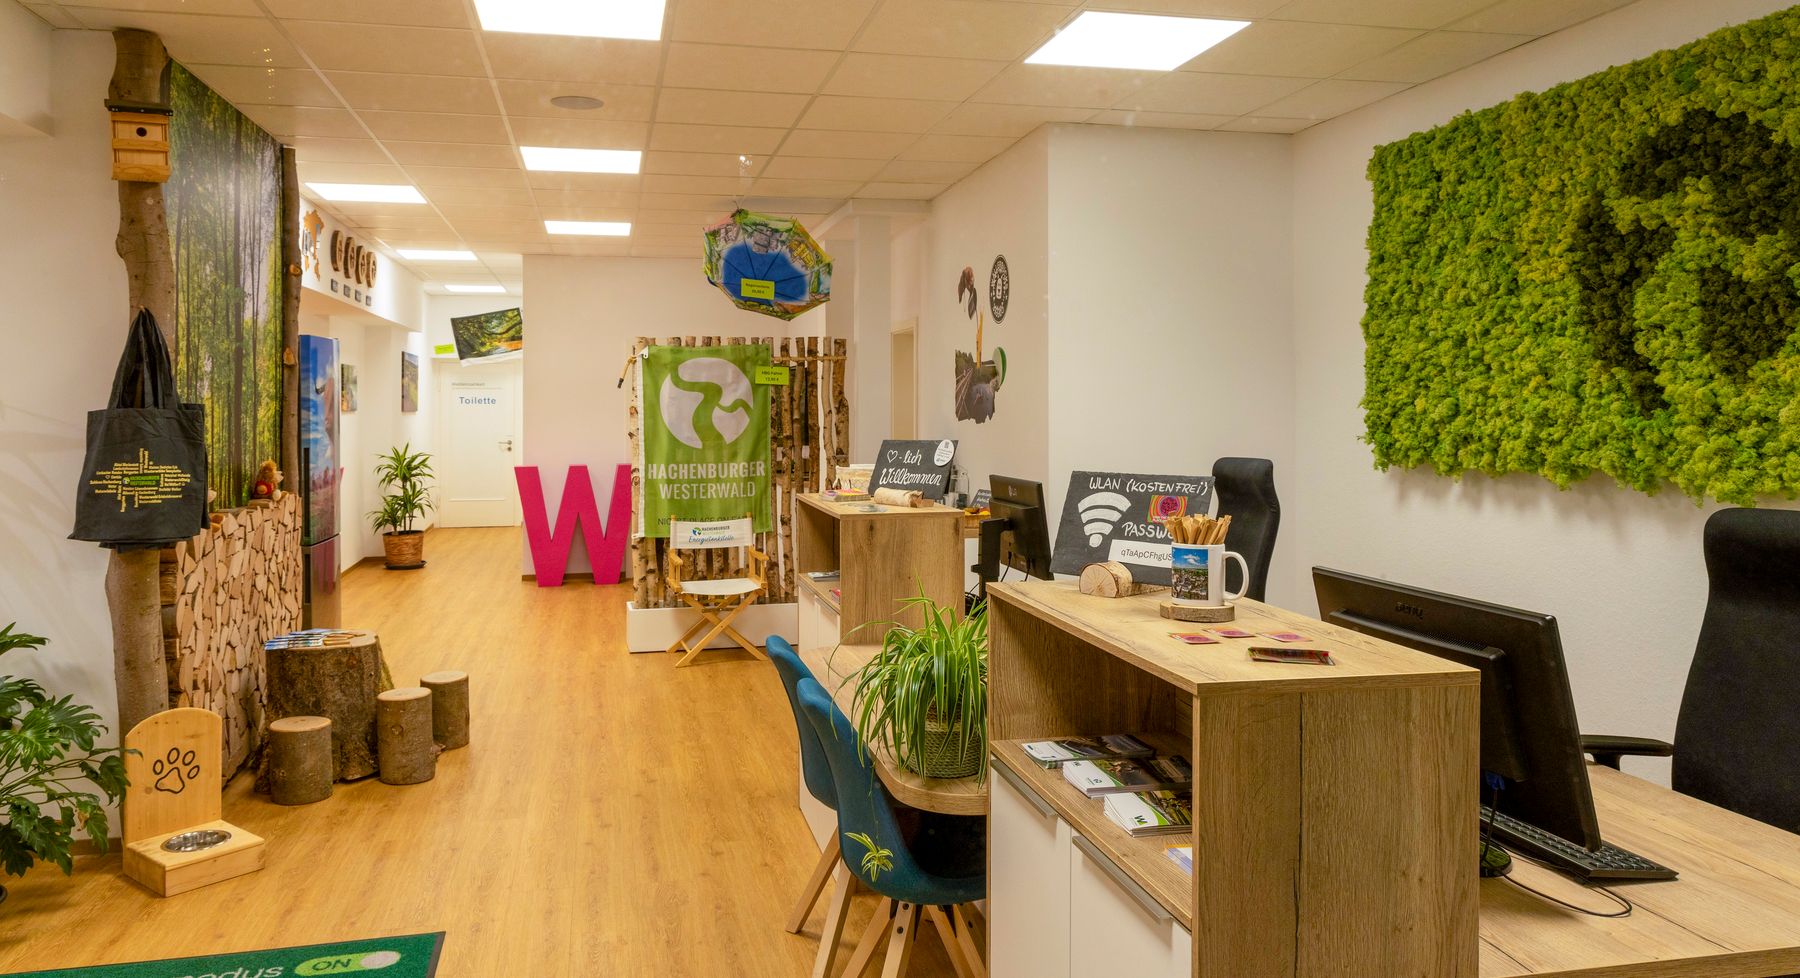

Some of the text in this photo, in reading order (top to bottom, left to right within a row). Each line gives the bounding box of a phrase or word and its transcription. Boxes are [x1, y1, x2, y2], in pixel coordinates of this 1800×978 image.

[459, 396, 497, 405] Toilette
[648, 461, 766, 480] HACHENBURGER
[879, 466, 942, 486] Willkommen
[660, 481, 756, 500] WESTERWALD
[1089, 476, 1121, 490] WLAN
[513, 463, 632, 588] W
[312, 958, 351, 971] ON
